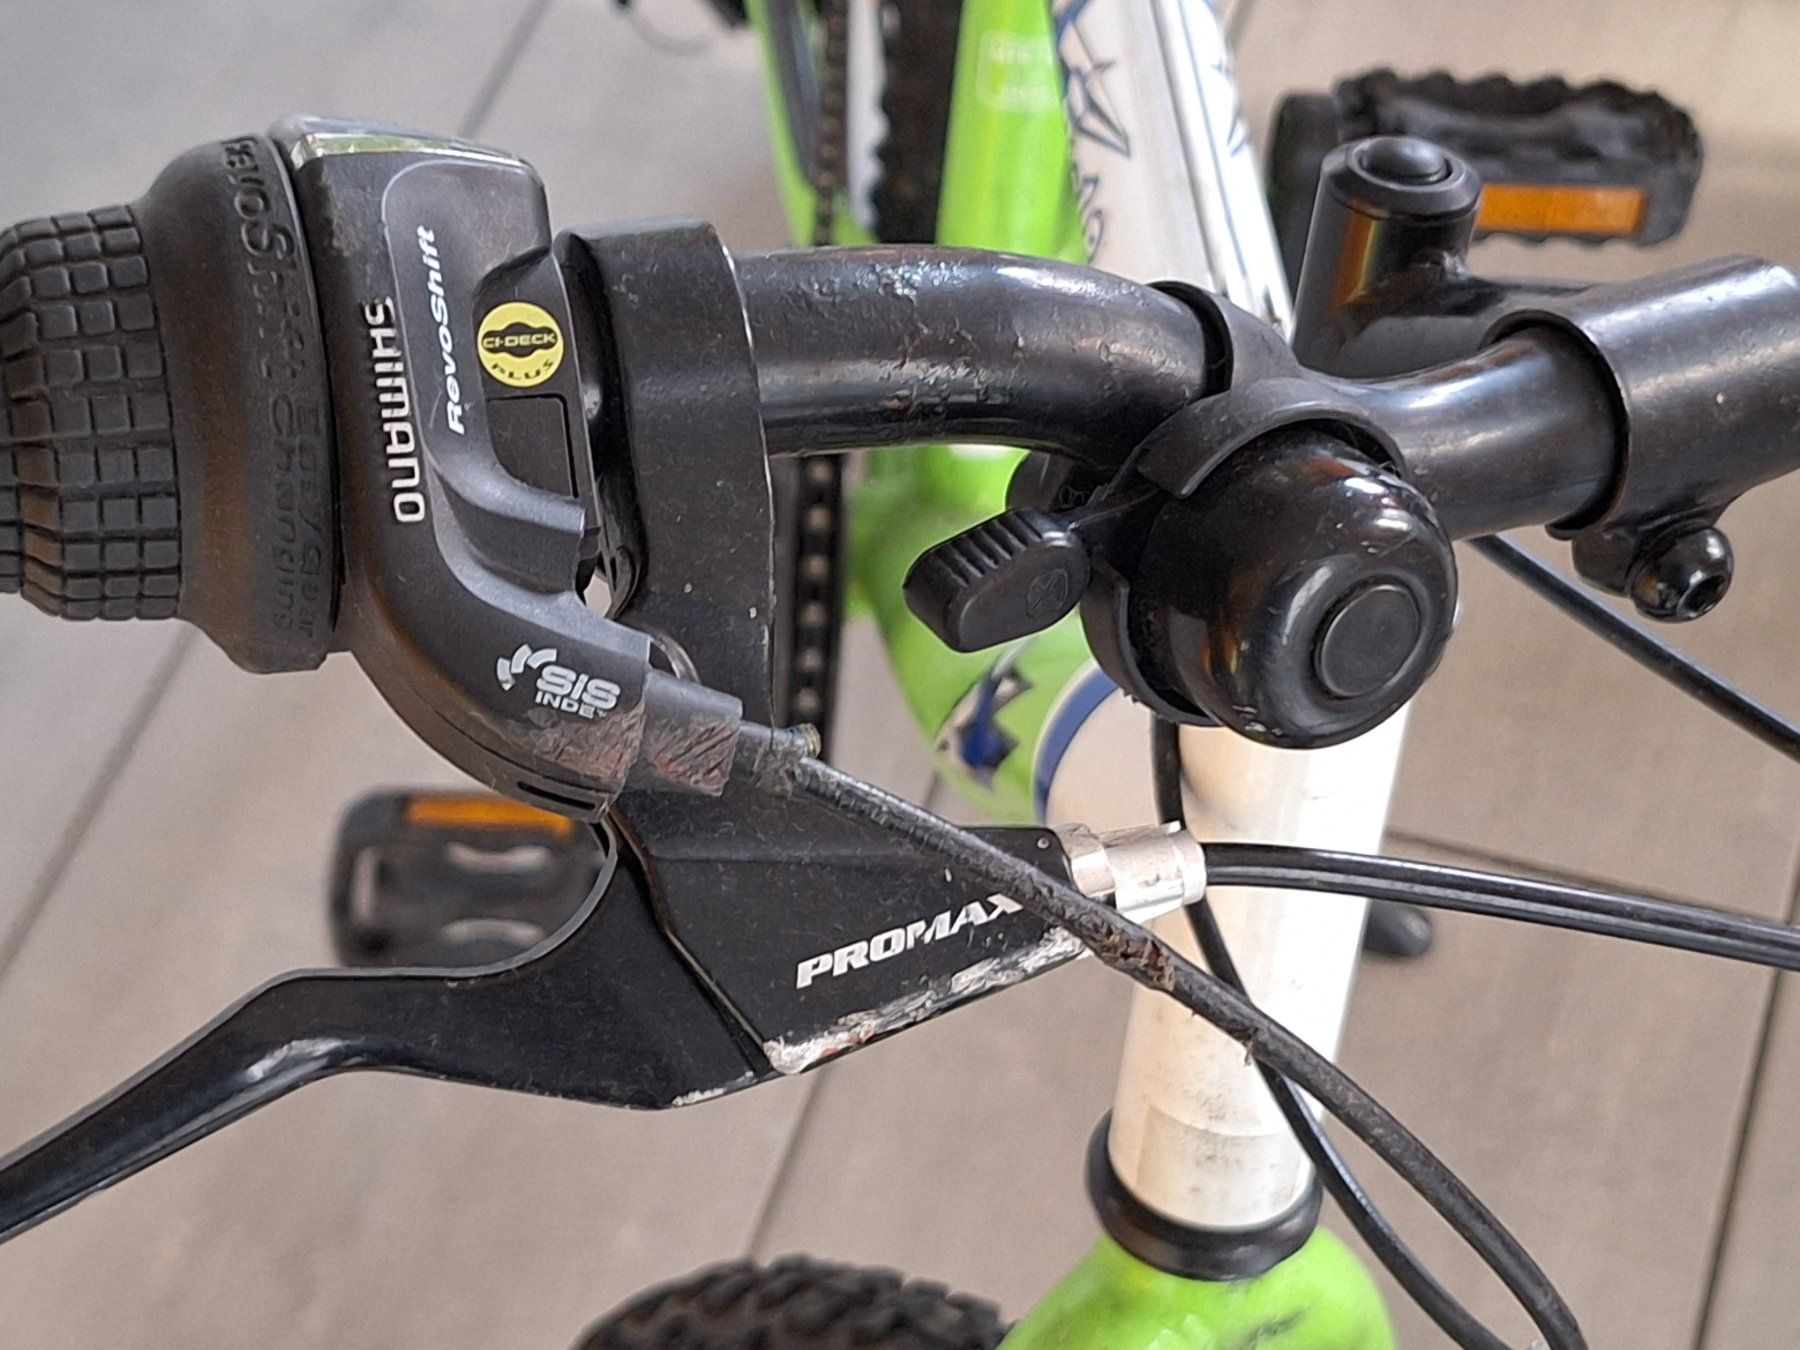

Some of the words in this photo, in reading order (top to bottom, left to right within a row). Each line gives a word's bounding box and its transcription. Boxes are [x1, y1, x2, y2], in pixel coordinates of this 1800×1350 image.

[416, 225, 466, 435] RevoShift
[491, 358, 555, 381] PLUS
[365, 296, 426, 523] SHIMANO
[535, 664, 622, 710] SIS
